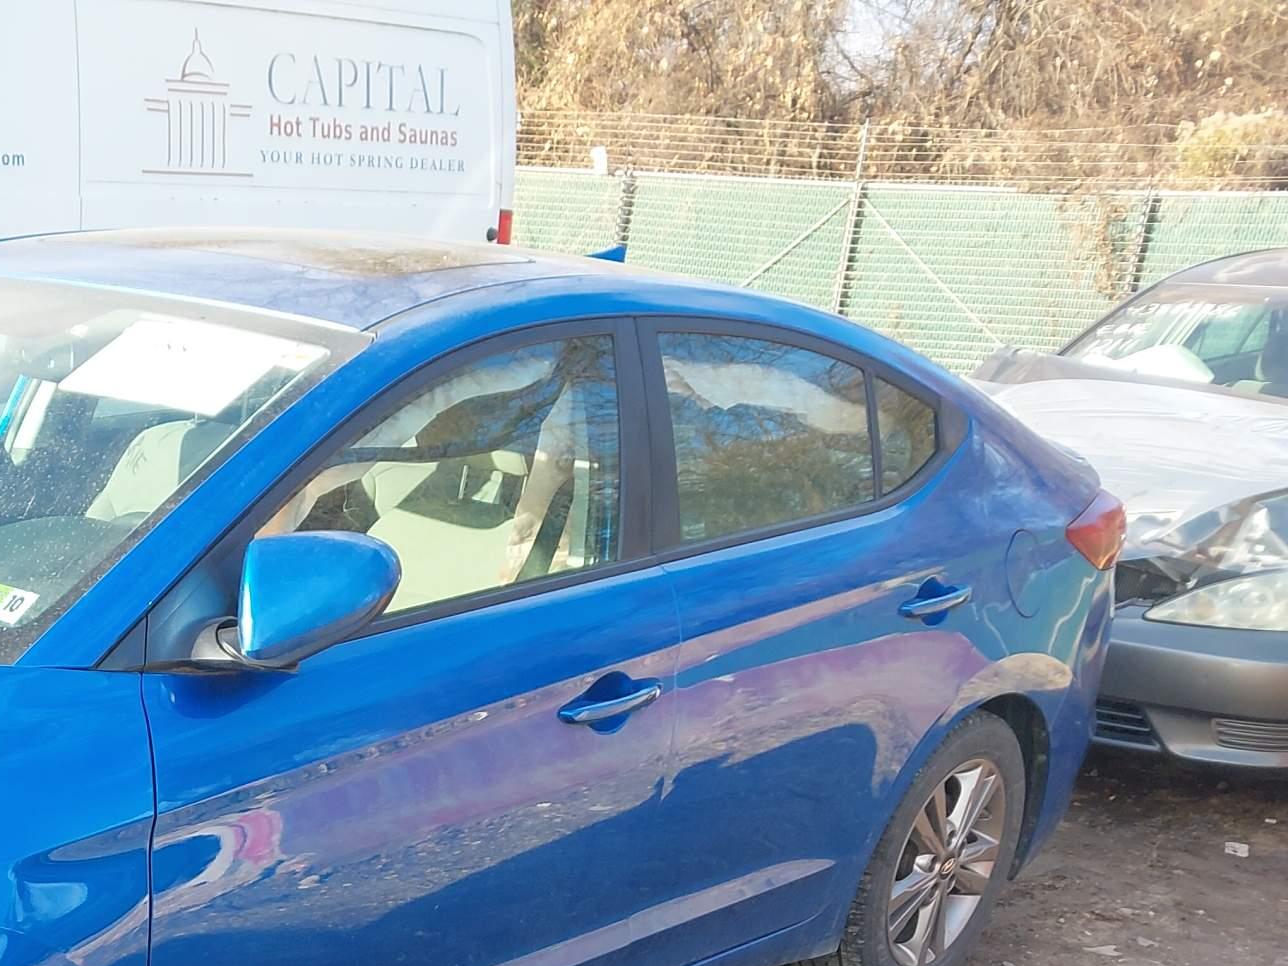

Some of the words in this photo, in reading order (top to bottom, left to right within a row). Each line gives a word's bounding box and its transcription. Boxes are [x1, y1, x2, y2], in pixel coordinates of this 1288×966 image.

[267, 52, 461, 116] CAPITAL
[269, 113, 303, 138] Hot
[309, 116, 353, 141] Tubs
[359, 121, 392, 143] and
[398, 122, 458, 147] Saunas
[260, 149, 304, 165] YOUR
[311, 152, 345, 167] HOT
[350, 154, 404, 169] SPRING
[410, 157, 465, 172] DEALER
